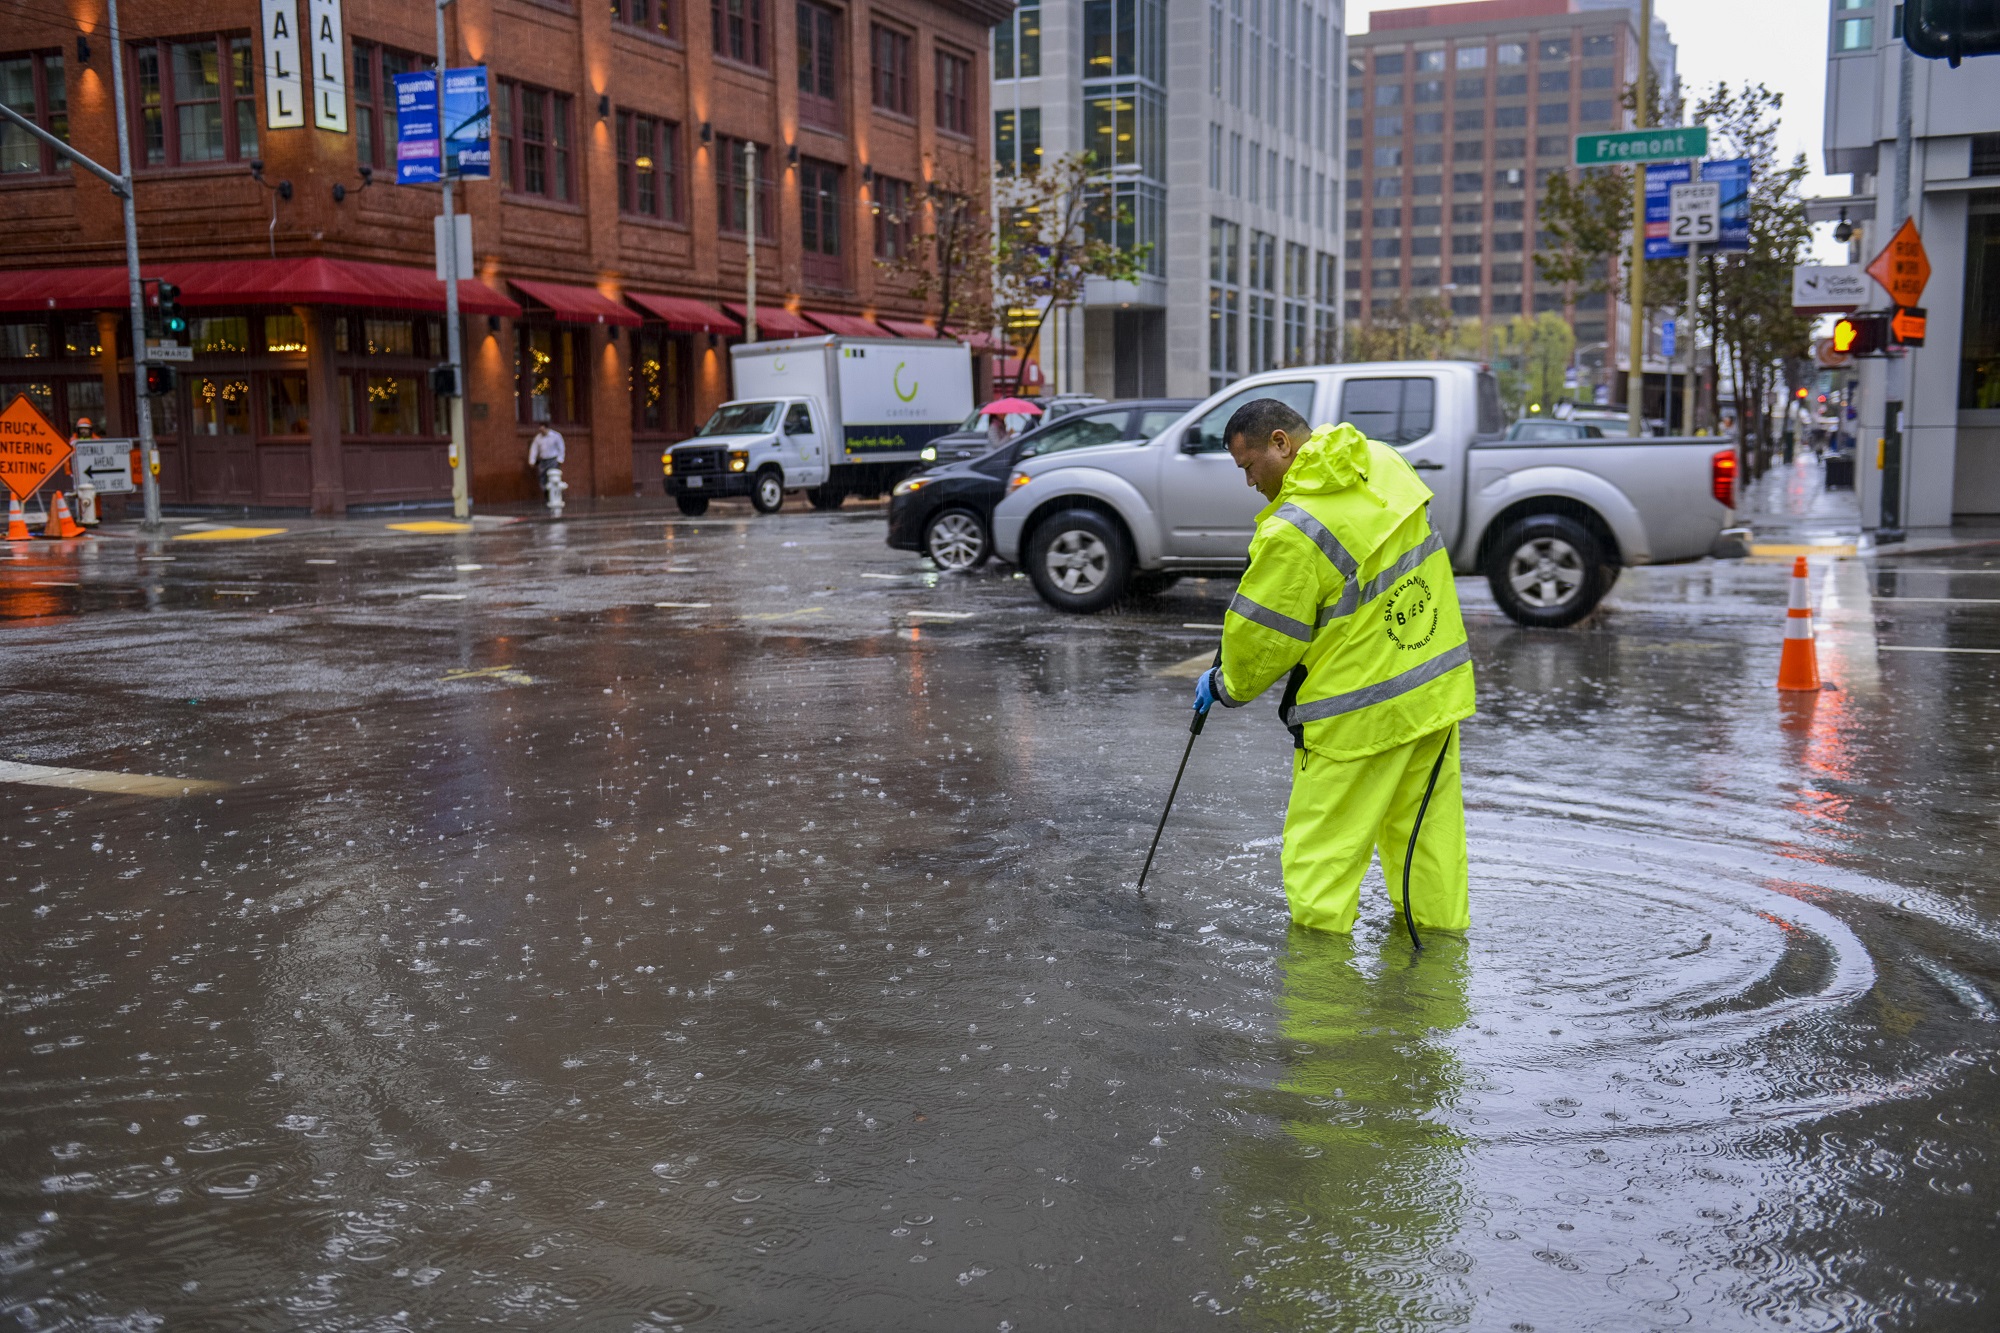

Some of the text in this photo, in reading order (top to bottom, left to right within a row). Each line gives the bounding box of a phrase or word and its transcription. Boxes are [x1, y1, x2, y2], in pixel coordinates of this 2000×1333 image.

[319, 0, 337, 119] ALL
[1596, 135, 1685, 158] Fremont
[1676, 187, 1715, 198] SPEED
[1678, 201, 1711, 212] LIMIT
[1676, 215, 1713, 236] 25
[150, 349, 189, 358] HOWARD
[0, 461, 46, 475] EXITING
[93, 456, 114, 468] AHEAD
[1383, 599, 1396, 622] SAN
[1407, 635, 1431, 651] PUBLIC
